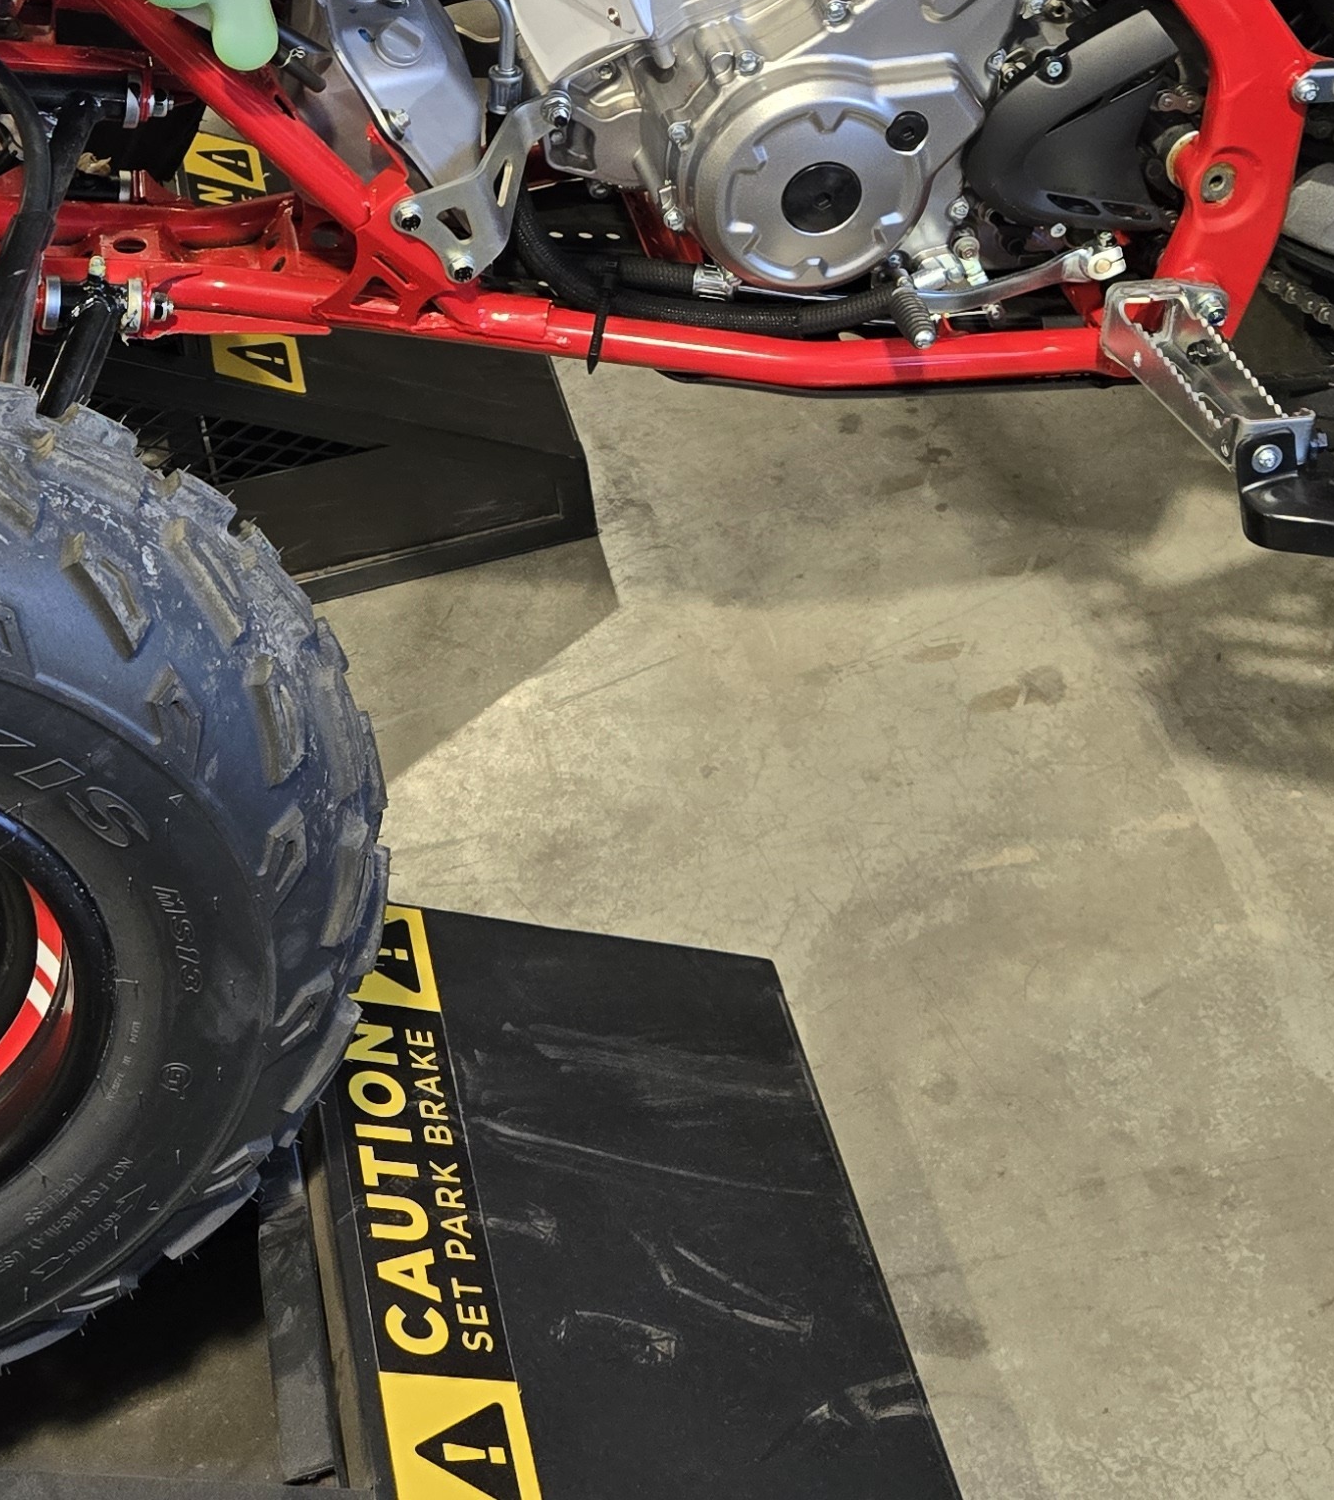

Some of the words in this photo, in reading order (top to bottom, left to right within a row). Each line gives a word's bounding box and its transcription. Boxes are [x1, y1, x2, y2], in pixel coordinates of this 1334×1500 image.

[404, 1028, 454, 1146] BRAKE
[67, 1211, 122, 1257] ROTATION
[344, 1022, 449, 1356] CAUTION
[428, 1160, 477, 1262] PARK
[451, 1278, 495, 1353] SET
